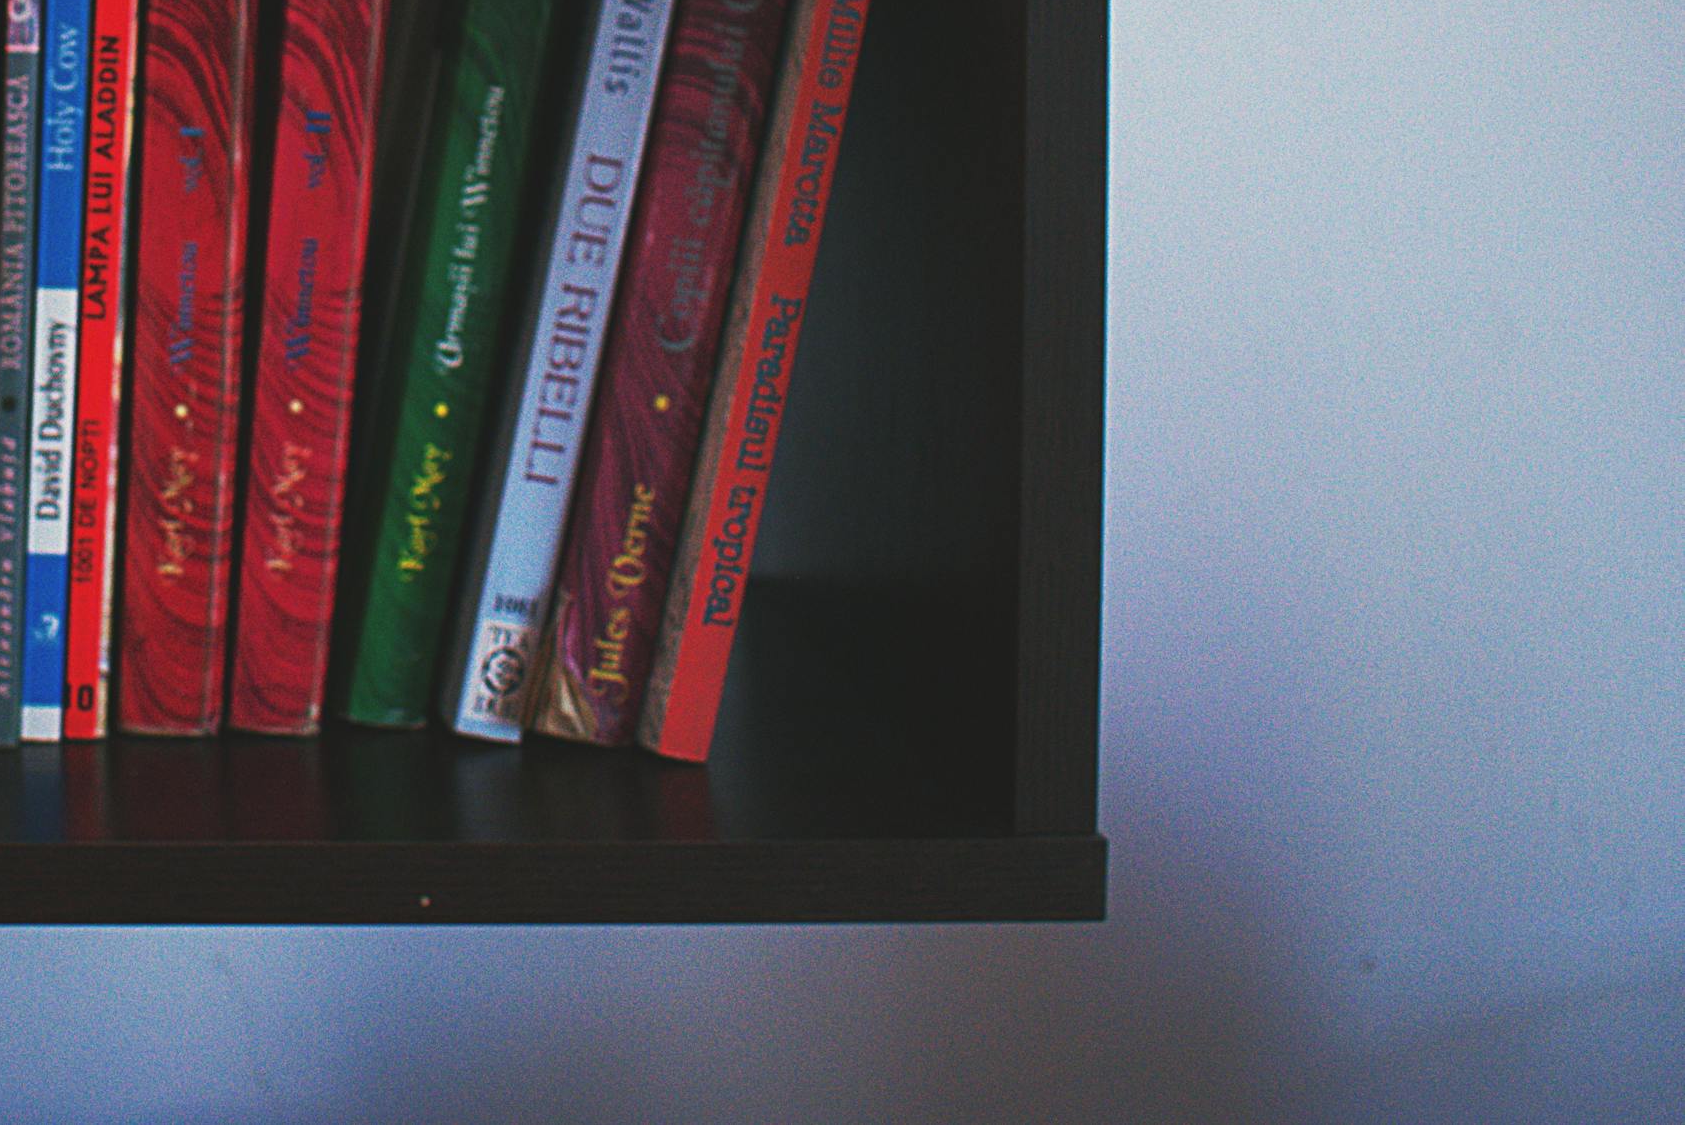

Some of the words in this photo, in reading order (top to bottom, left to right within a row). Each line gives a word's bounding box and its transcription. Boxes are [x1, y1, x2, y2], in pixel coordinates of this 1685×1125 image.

[48, 22, 79, 92] Cow
[93, 35, 121, 161] ALADDIN
[44, 101, 84, 172] Holy
[91, 172, 113, 216] LUI
[782, 103, 842, 250] Marotta
[566, 154, 624, 272] DUE
[85, 226, 112, 321] LAMPA
[36, 318, 71, 443] Duchovny
[523, 283, 602, 488] RIBELLI
[736, 294, 803, 473] Paradisul
[34, 449, 62, 522] David
[76, 497, 97, 529] DE
[610, 482, 658, 602] Verne
[702, 482, 757, 629] tropical
[585, 604, 643, 704] Jules
